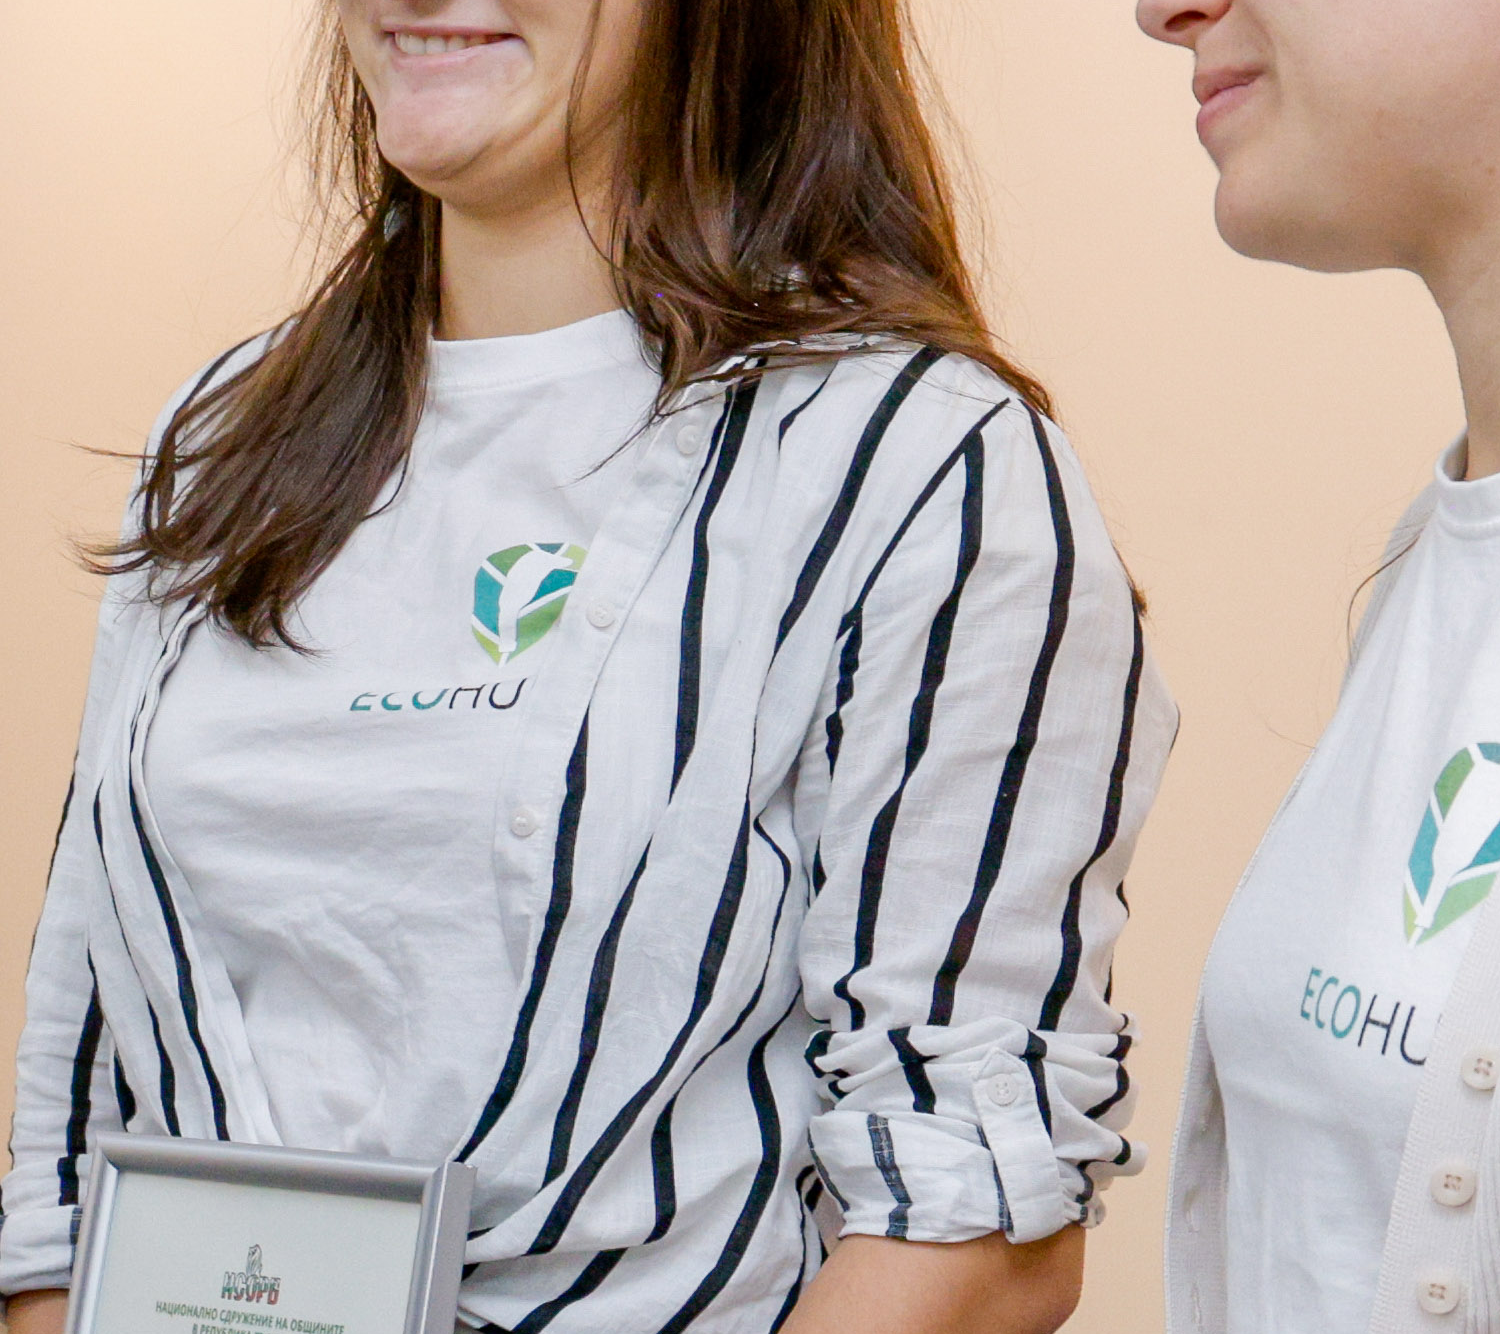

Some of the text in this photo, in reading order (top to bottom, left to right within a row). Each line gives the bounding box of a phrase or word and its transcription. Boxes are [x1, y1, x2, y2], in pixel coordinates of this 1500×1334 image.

[221, 1271, 282, 1306] НСОРБ
[155, 1301, 218, 1322] НАЦИОНАЛНО
[219, 1309, 273, 1327] СДРУЖЕНИЕ
[275, 1319, 288, 1331] НА
